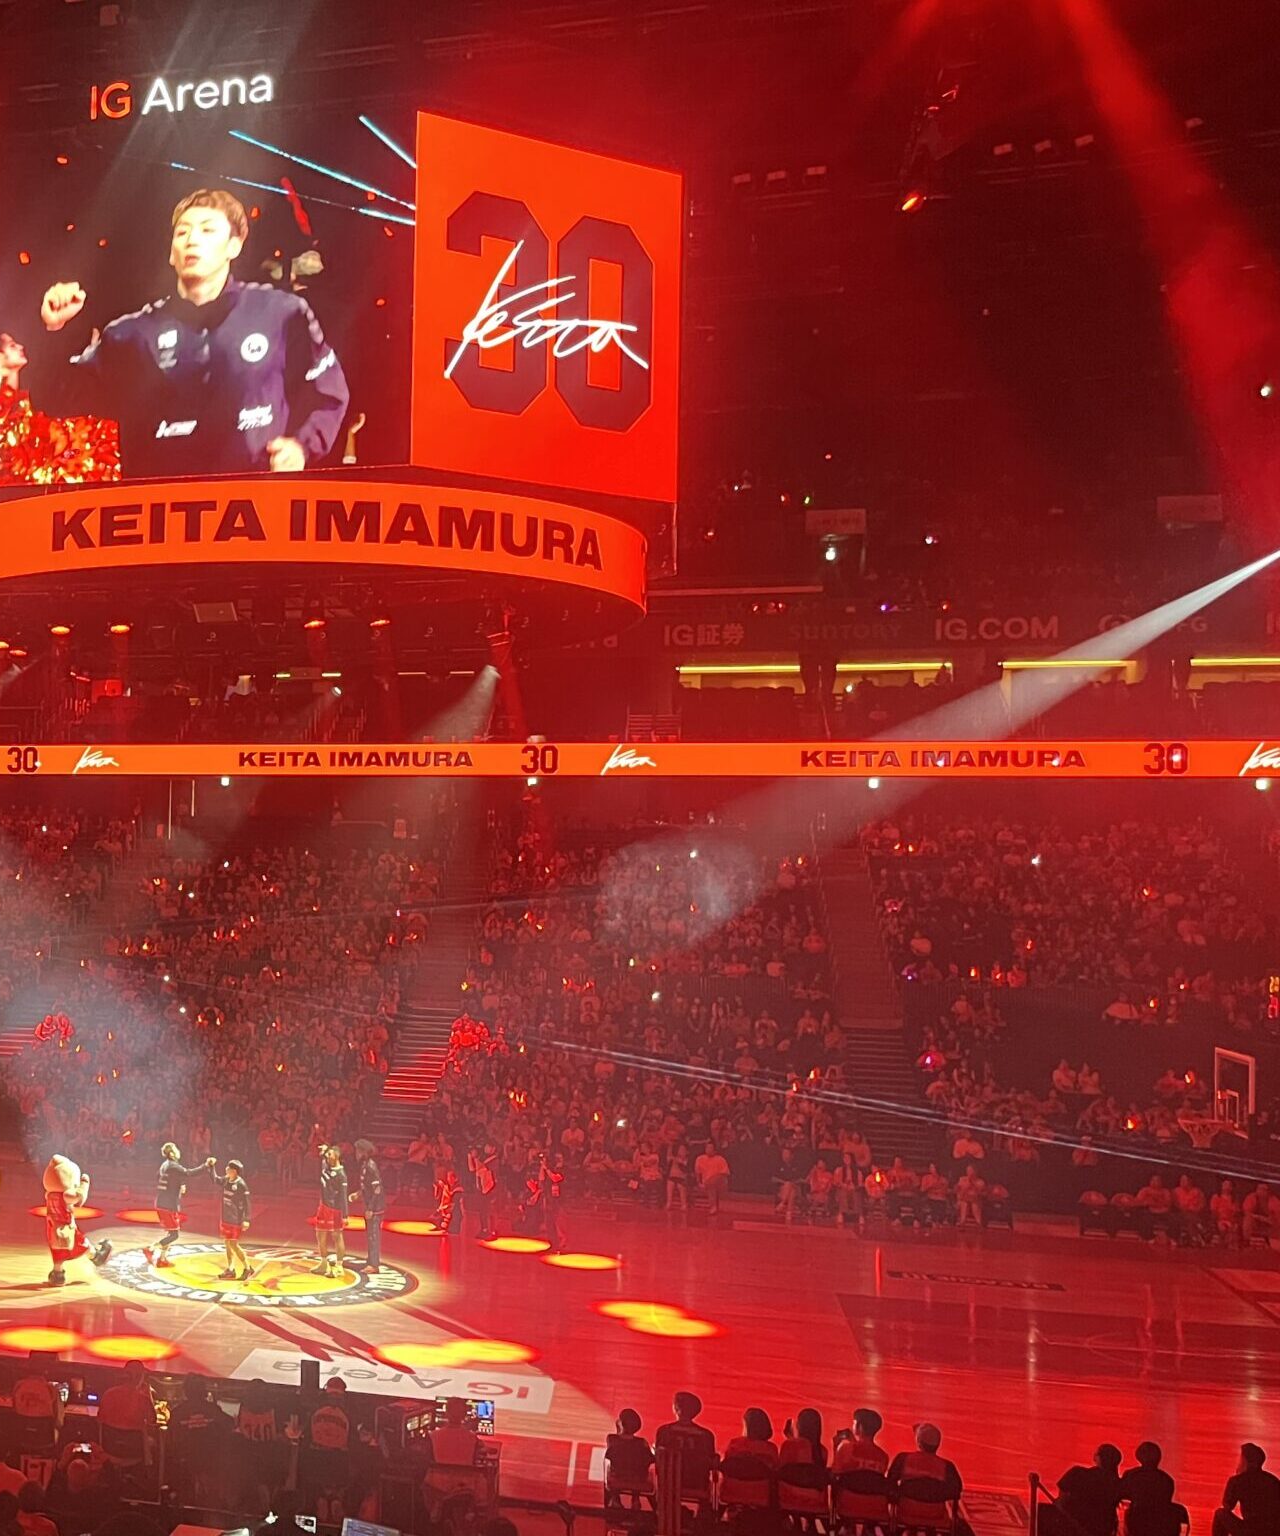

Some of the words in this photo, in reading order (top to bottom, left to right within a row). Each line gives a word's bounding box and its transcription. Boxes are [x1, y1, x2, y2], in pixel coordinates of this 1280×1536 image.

[91, 82, 131, 121] IG
[142, 74, 274, 116] Arena
[445, 190, 654, 432] 30
[52, 499, 267, 552] KEITA
[288, 498, 603, 572] IMAMURA
[664, 623, 744, 646] IG証券
[935, 616, 1059, 640] IG.COM
[7, 747, 38, 773] 30
[238, 751, 321, 767] KEITA
[329, 751, 474, 767] IMAMURA
[521, 745, 559, 774] 30
[800, 750, 900, 768] KEITA
[911, 750, 1086, 768] IMAMURA
[1143, 742, 1189, 775] 30
[467, 1382, 530, 1399] IG
